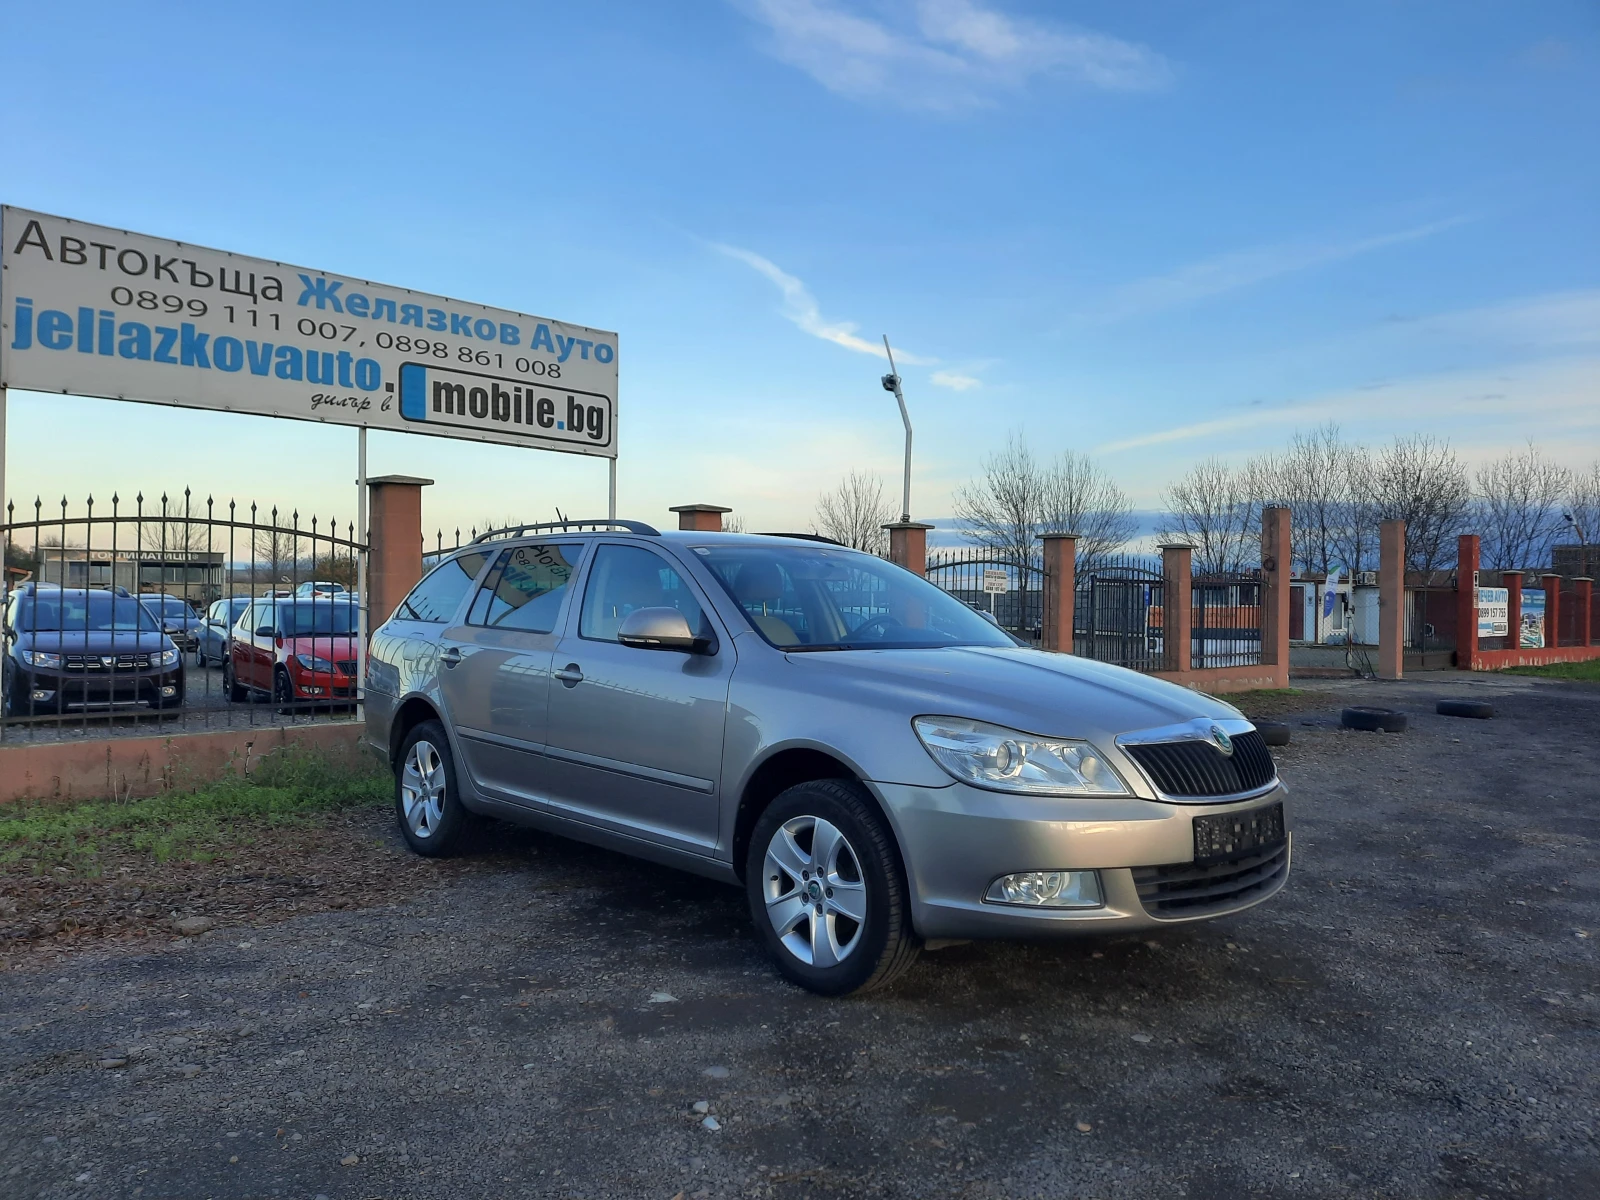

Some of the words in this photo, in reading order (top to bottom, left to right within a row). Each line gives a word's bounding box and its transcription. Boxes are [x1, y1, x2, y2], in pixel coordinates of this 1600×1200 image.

[13, 220, 283, 304] Автокъща
[297, 273, 520, 346] Желязков
[530, 323, 614, 364] Ауто
[111, 286, 208, 317] 0899
[223, 306, 280, 331] 111
[297, 318, 365, 347] 007,
[375, 332, 449, 358] 0898
[457, 346, 504, 369] 861
[515, 357, 561, 378] 008
[432, 380, 604, 440] mobile.bg
